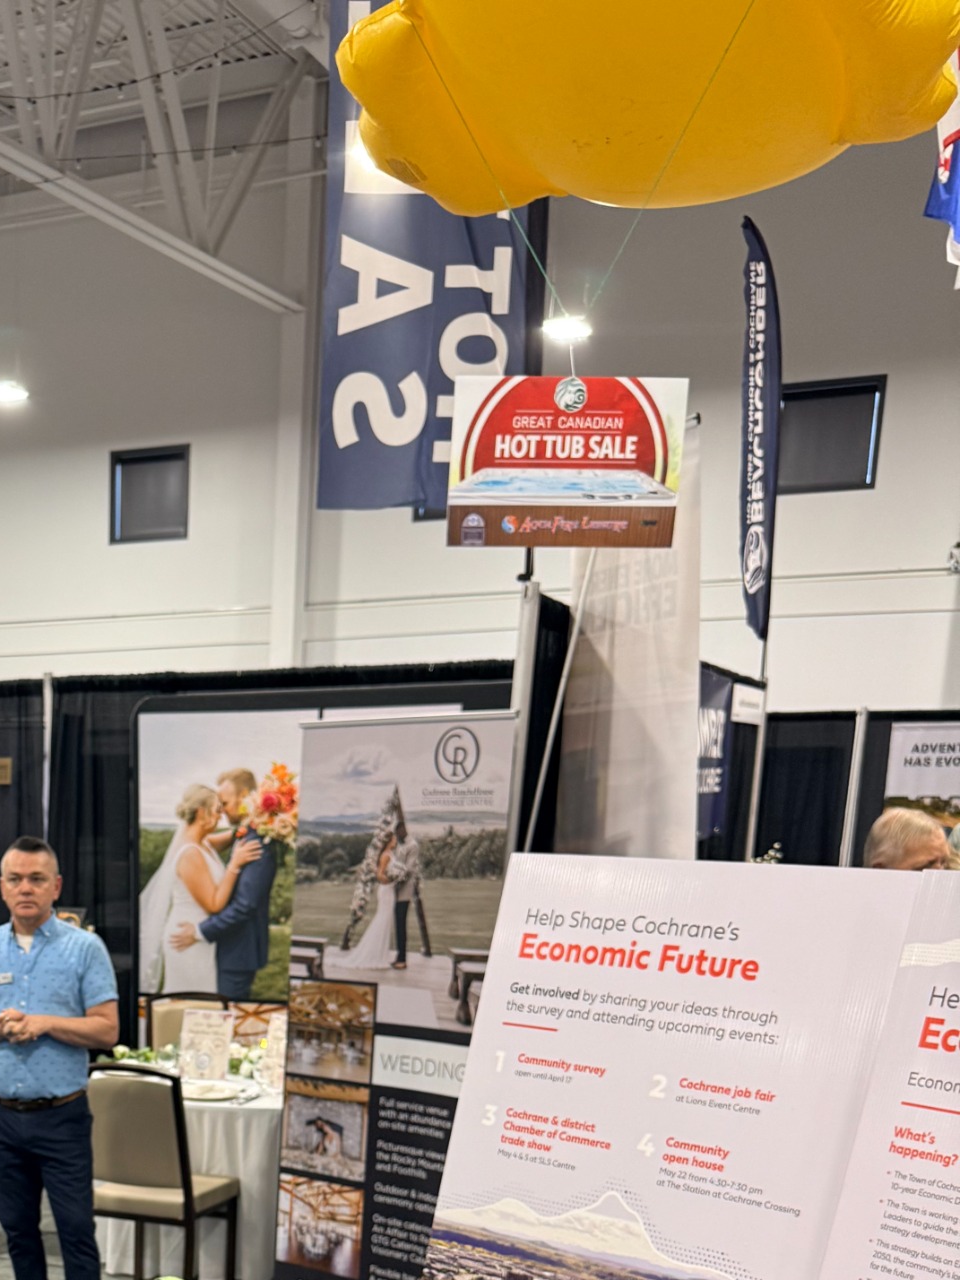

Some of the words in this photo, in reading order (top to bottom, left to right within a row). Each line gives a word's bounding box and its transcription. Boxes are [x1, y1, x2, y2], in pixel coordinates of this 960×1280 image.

[512, 416, 553, 429] GREAT
[558, 416, 624, 430] CANADIAN
[494, 434, 540, 458] HOT
[542, 435, 585, 459] TUB
[588, 436, 638, 460] SALE
[904, 756, 930, 768] HAS
[525, 908, 564, 930] Help
[568, 910, 626, 935] Shape
[631, 915, 739, 941] Cochrane's
[518, 933, 650, 970] Economic
[657, 944, 759, 981] Future
[509, 981, 530, 995] Get
[531, 983, 581, 1000] involved
[582, 989, 597, 1005] by
[599, 992, 647, 1011] sharing
[648, 1000, 679, 1012] your
[681, 1000, 718, 1017] ideas
[721, 1006, 777, 1026] through
[506, 999, 525, 1012] the
[526, 1004, 564, 1020] survey
[565, 1008, 590, 1020] and
[592, 1011, 655, 1031] attending
[658, 1020, 725, 1041] upcoming
[728, 1029, 779, 1044] events:
[918, 1016, 960, 1052] Ec
[495, 1050, 506, 1072] 1
[517, 1053, 571, 1072] Community
[573, 1064, 606, 1077] survey
[648, 1074, 667, 1098] 2
[679, 1077, 731, 1095] Cochrane
[731, 1086, 751, 1099] job
[754, 1089, 776, 1102] fair
[481, 1104, 498, 1126] 3
[685, 1096, 706, 1106] Lions
[708, 1099, 731, 1110] Event
[732, 1103, 760, 1115] Centre
[506, 1107, 549, 1124] Cochrane
[550, 1115, 558, 1126] &
[560, 1118, 595, 1132] district
[500, 1134, 525, 1147] trade
[527, 1140, 551, 1152] show
[503, 1120, 545, 1136] Chamber
[546, 1129, 558, 1139] of
[558, 1131, 611, 1149] Commerce
[636, 1133, 655, 1157] 4
[894, 1126, 935, 1144] What's
[665, 1136, 729, 1159] Community
[888, 1141, 958, 1167] happening?
[662, 1153, 689, 1165] open
[691, 1156, 724, 1172] house
[658, 1167, 676, 1178] May
[676, 1170, 687, 1179] 22
[688, 1172, 707, 1183] from
[748, 1186, 763, 1195] pm
[894, 1170, 907, 1180] The
[908, 1173, 926, 1184] Town
[667, 1179, 681, 1190] The
[682, 1183, 710, 1196] Station
[722, 1191, 762, 1207] Cochrane
[763, 1200, 801, 1217] Crossing
